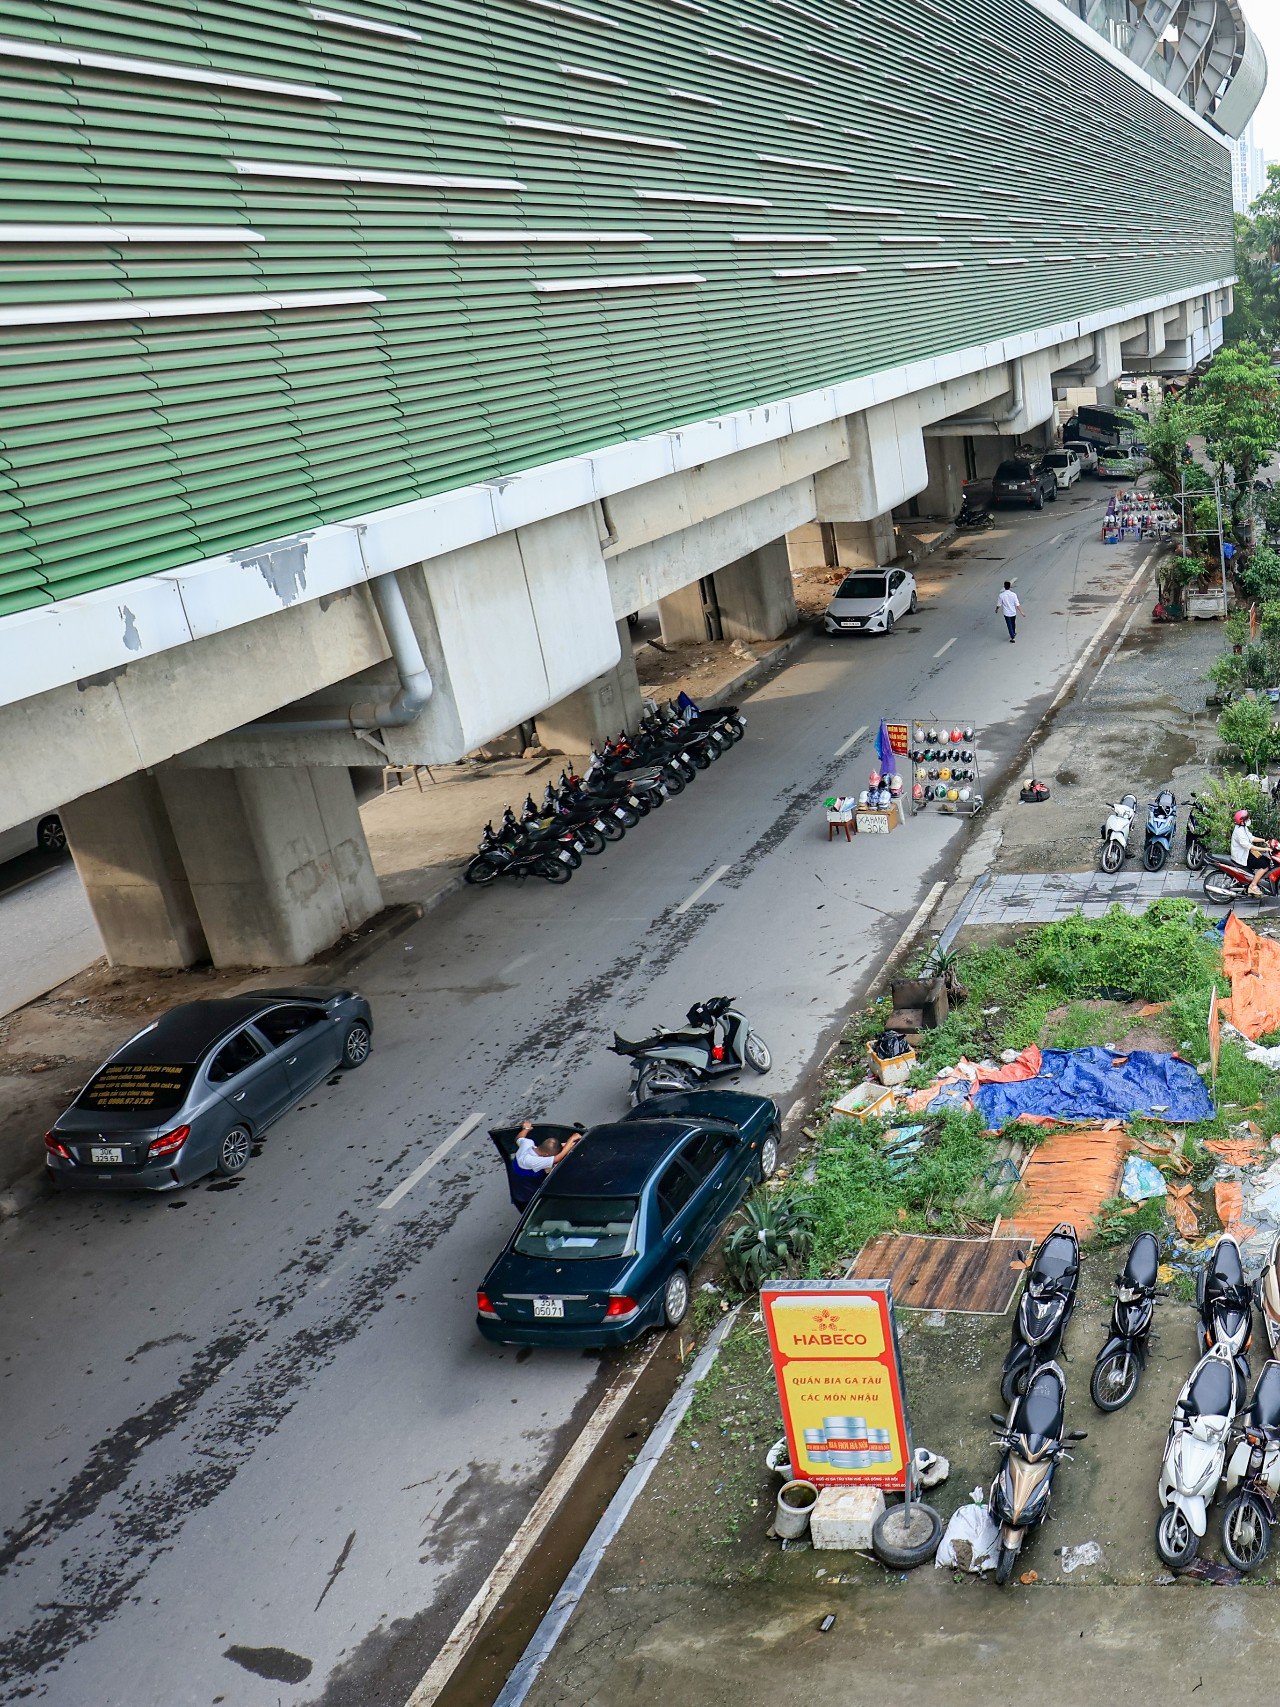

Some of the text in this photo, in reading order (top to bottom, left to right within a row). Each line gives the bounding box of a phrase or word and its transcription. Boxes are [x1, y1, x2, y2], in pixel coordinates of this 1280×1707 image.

[868, 825, 884, 833] 30K
[793, 1334, 867, 1345] HABECO
[792, 1376, 821, 1386] QUÁN
[862, 1375, 882, 1384] TÀU
[800, 1392, 879, 1403] CÁC MÓN NHẬU
